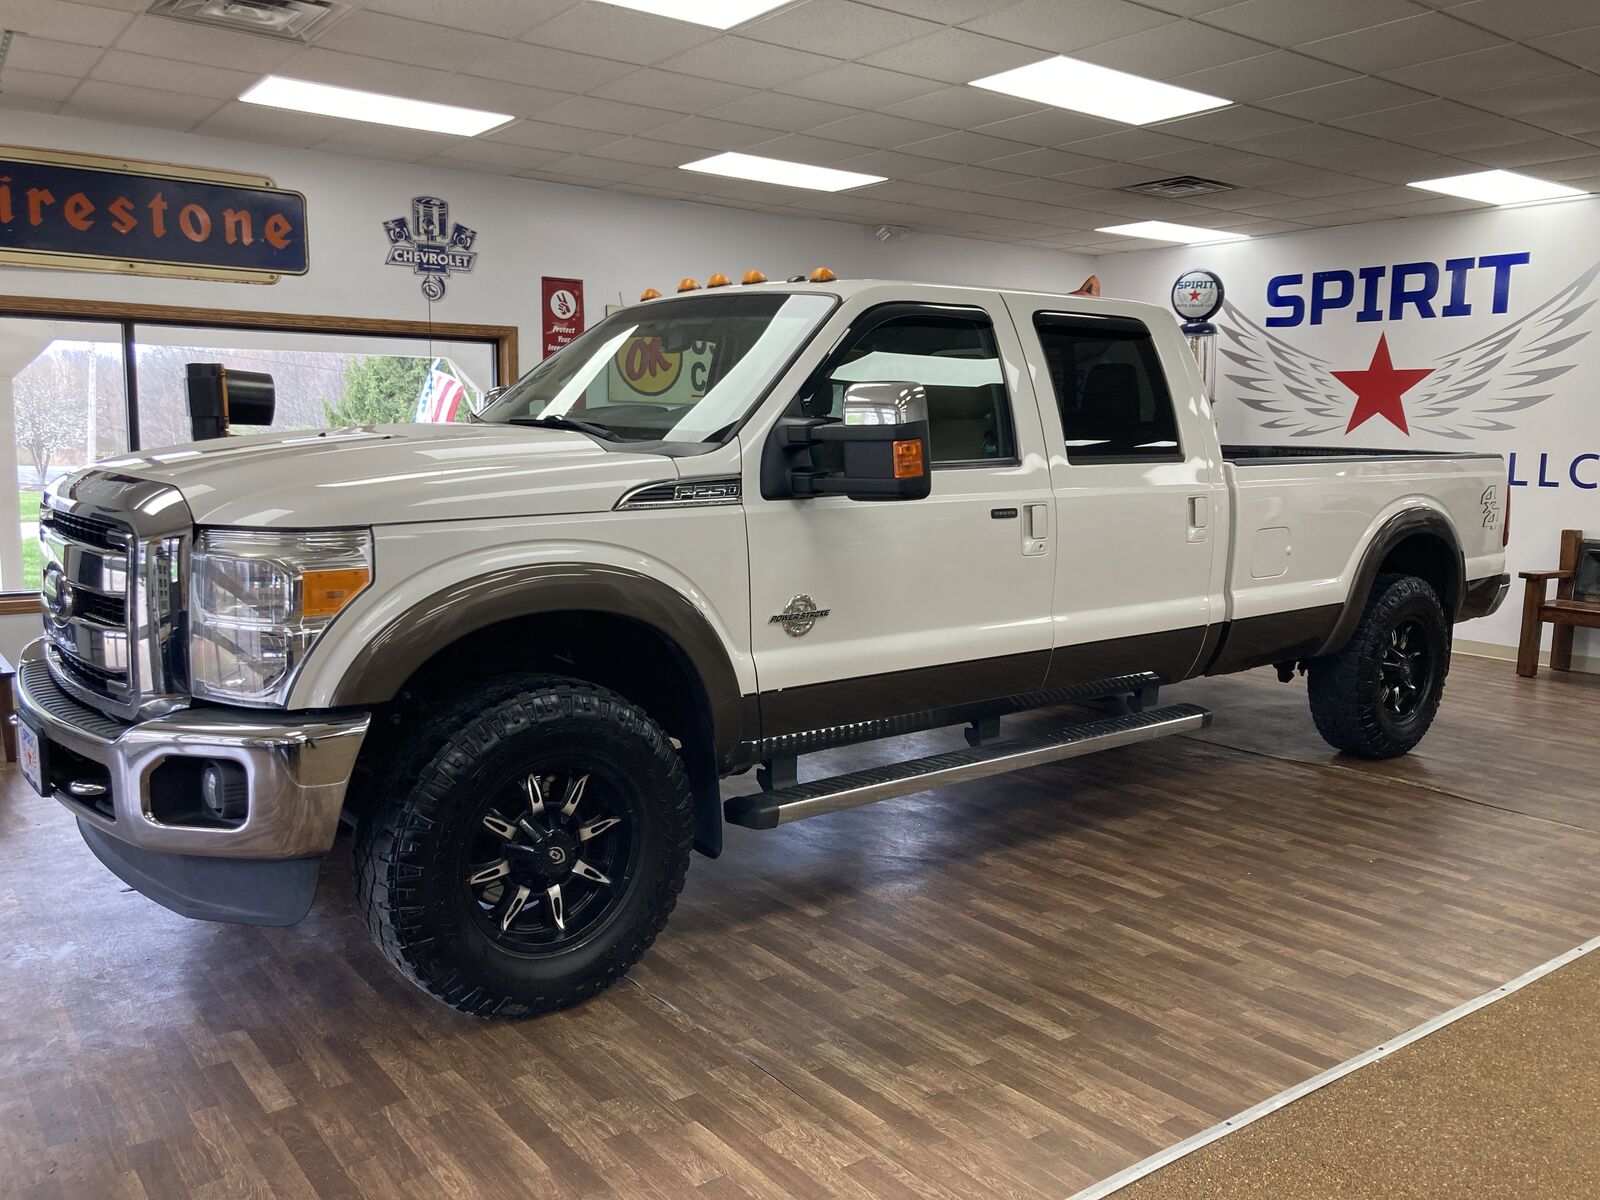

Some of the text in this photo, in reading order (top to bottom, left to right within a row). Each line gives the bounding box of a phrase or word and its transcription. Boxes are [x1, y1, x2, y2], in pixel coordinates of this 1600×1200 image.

[393, 249, 469, 267] CHEVROLET
[1177, 280, 1215, 290] SPIRIT
[1265, 251, 1531, 328] SPIRIT
[552, 325, 576, 334] Protect
[1507, 452, 1600, 490] LLC
[769, 609, 831, 623] POWER STROKE
